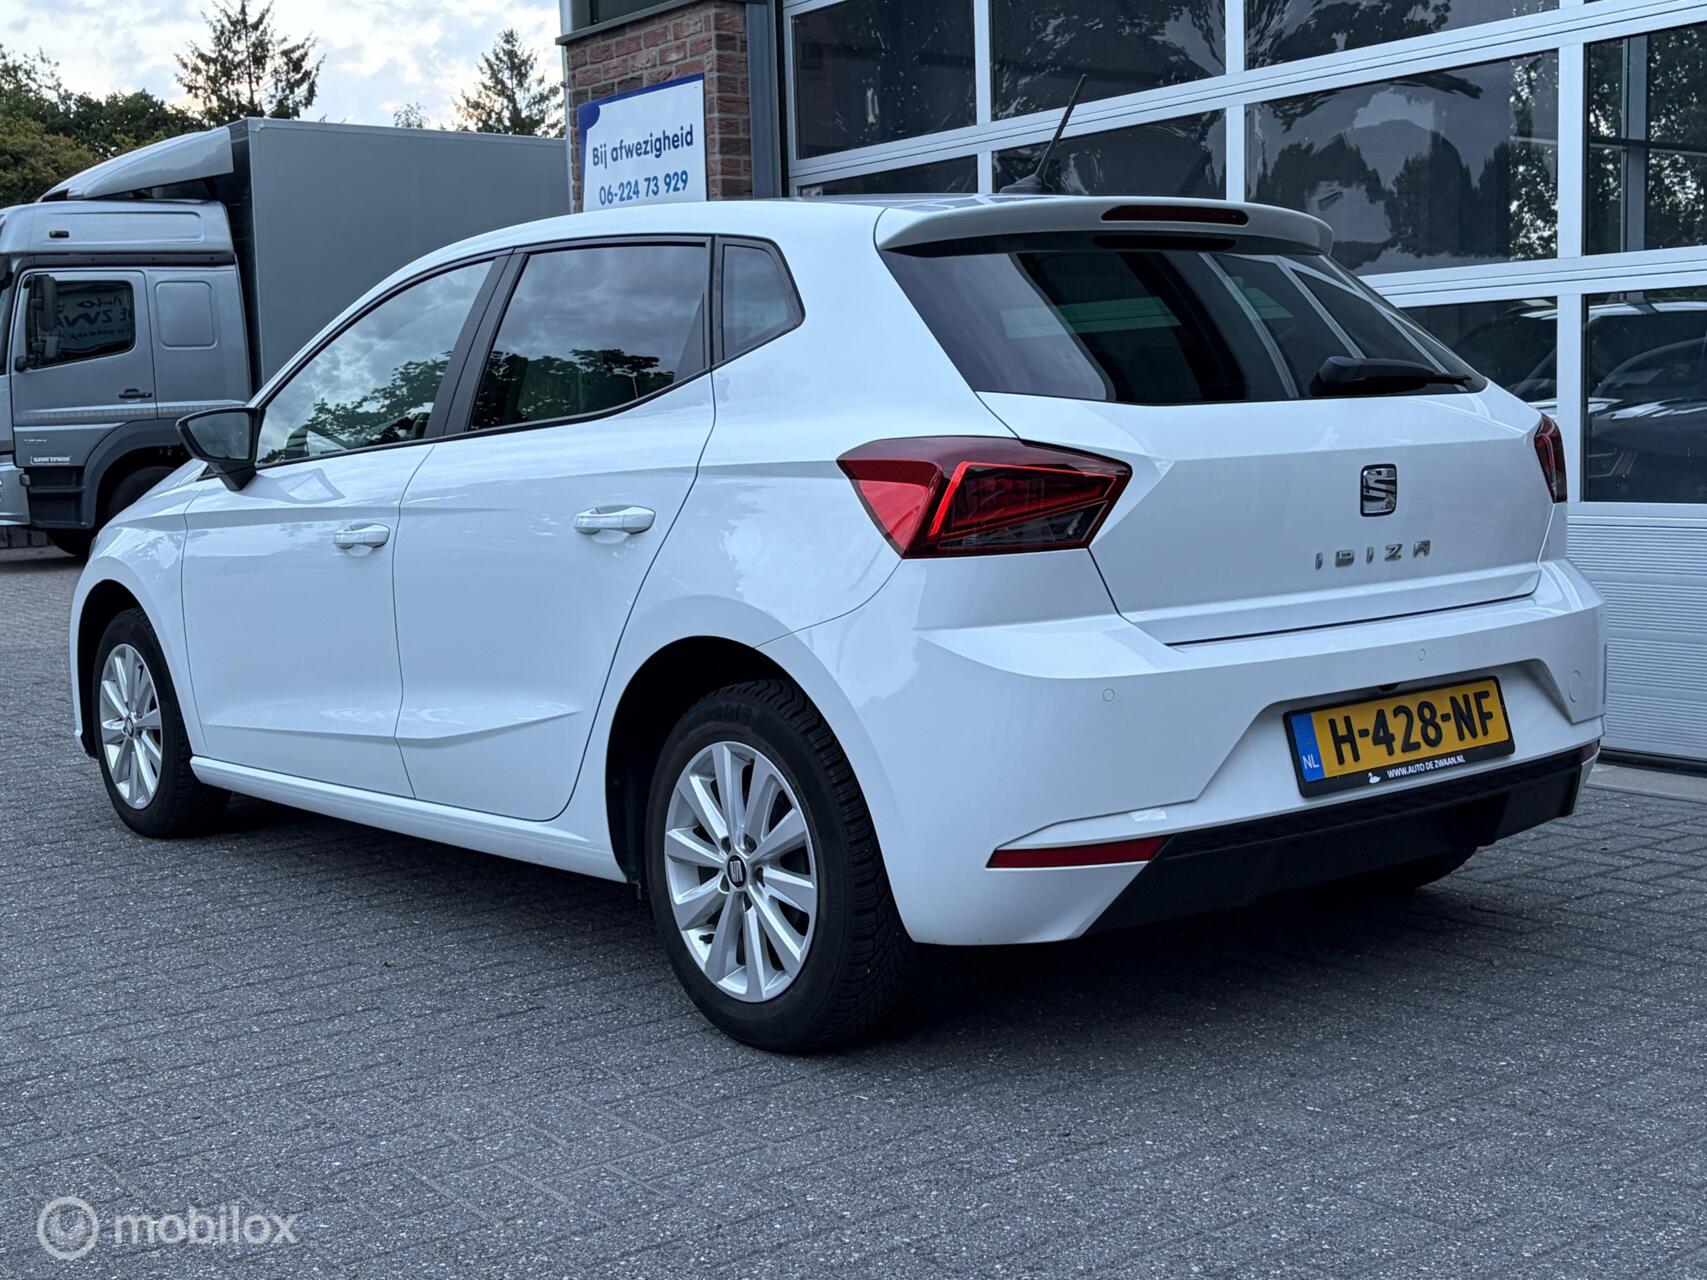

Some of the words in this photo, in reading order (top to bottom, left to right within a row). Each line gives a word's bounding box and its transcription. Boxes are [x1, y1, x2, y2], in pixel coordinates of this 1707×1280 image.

[592, 143, 608, 169] Bij
[611, 124, 694, 162] afwezigheid
[599, 179, 640, 206] 06-224
[644, 175, 659, 197] 73
[664, 170, 689, 194] 929
[1315, 540, 1431, 570] IBIZA
[1328, 690, 1494, 766] H-428-NF
[1302, 753, 1320, 769] NL
[1386, 763, 1425, 778] WWW.AUTO
[1425, 761, 1435, 770] DE
[1434, 754, 1466, 769] ZWAAN.NL
